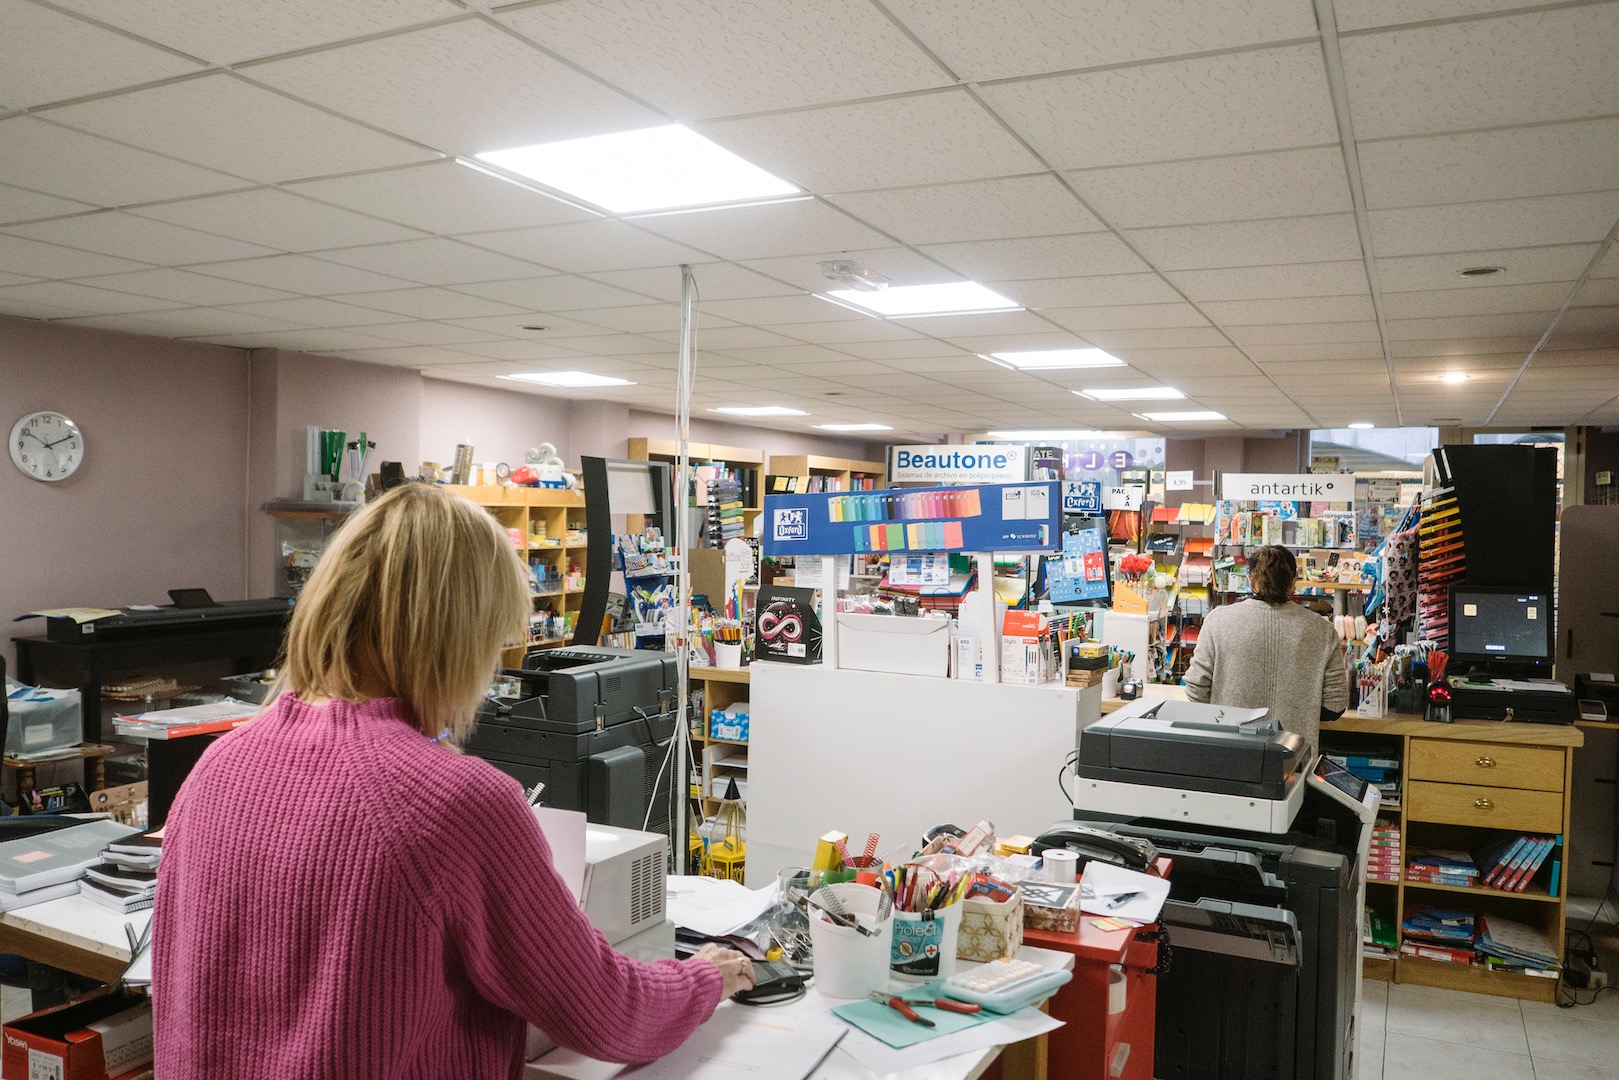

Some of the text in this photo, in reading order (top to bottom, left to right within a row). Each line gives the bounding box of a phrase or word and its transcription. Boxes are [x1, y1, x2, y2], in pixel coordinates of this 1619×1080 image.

[30, 419, 38, 427] 11
[42, 415, 51, 424] 12
[21, 428, 30, 437] 10
[66, 429, 73, 437] 2
[19, 441, 24, 449] 9
[70, 442, 76, 450] 3
[22, 454, 28, 463] 8
[31, 464, 37, 472] 7
[61, 464, 67, 473] 5
[46, 469, 52, 478] 6
[969, 472, 1013, 480] polipropileno
[1067, 497, 1095, 508] Oxford
[779, 525, 802, 536] Oxford
[973, 883, 990, 895] PLUS
